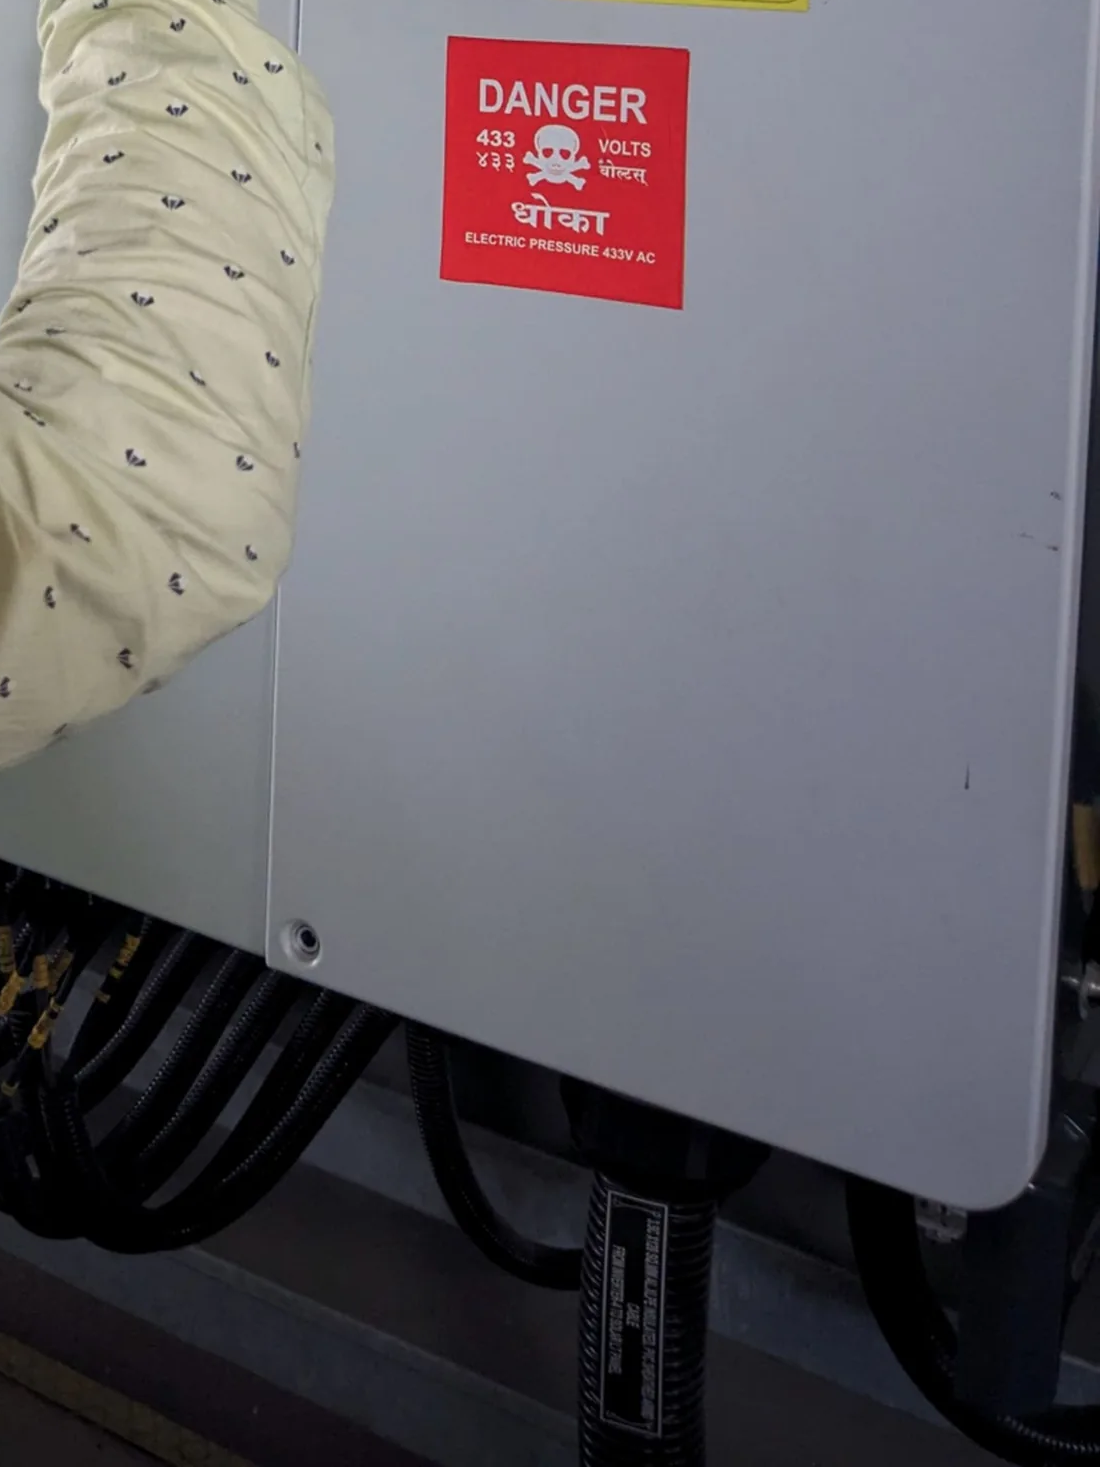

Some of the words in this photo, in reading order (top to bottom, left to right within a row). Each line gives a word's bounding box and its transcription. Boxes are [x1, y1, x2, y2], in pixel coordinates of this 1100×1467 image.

[479, 78, 648, 124] DANGER
[476, 129, 516, 148] 433
[598, 138, 652, 158] VOLTS
[511, 193, 610, 236] धोका
[465, 232, 526, 249] ELECTRIC
[529, 238, 600, 258] PRESSURE
[602, 247, 634, 261] 433V
[636, 251, 656, 264] AC
